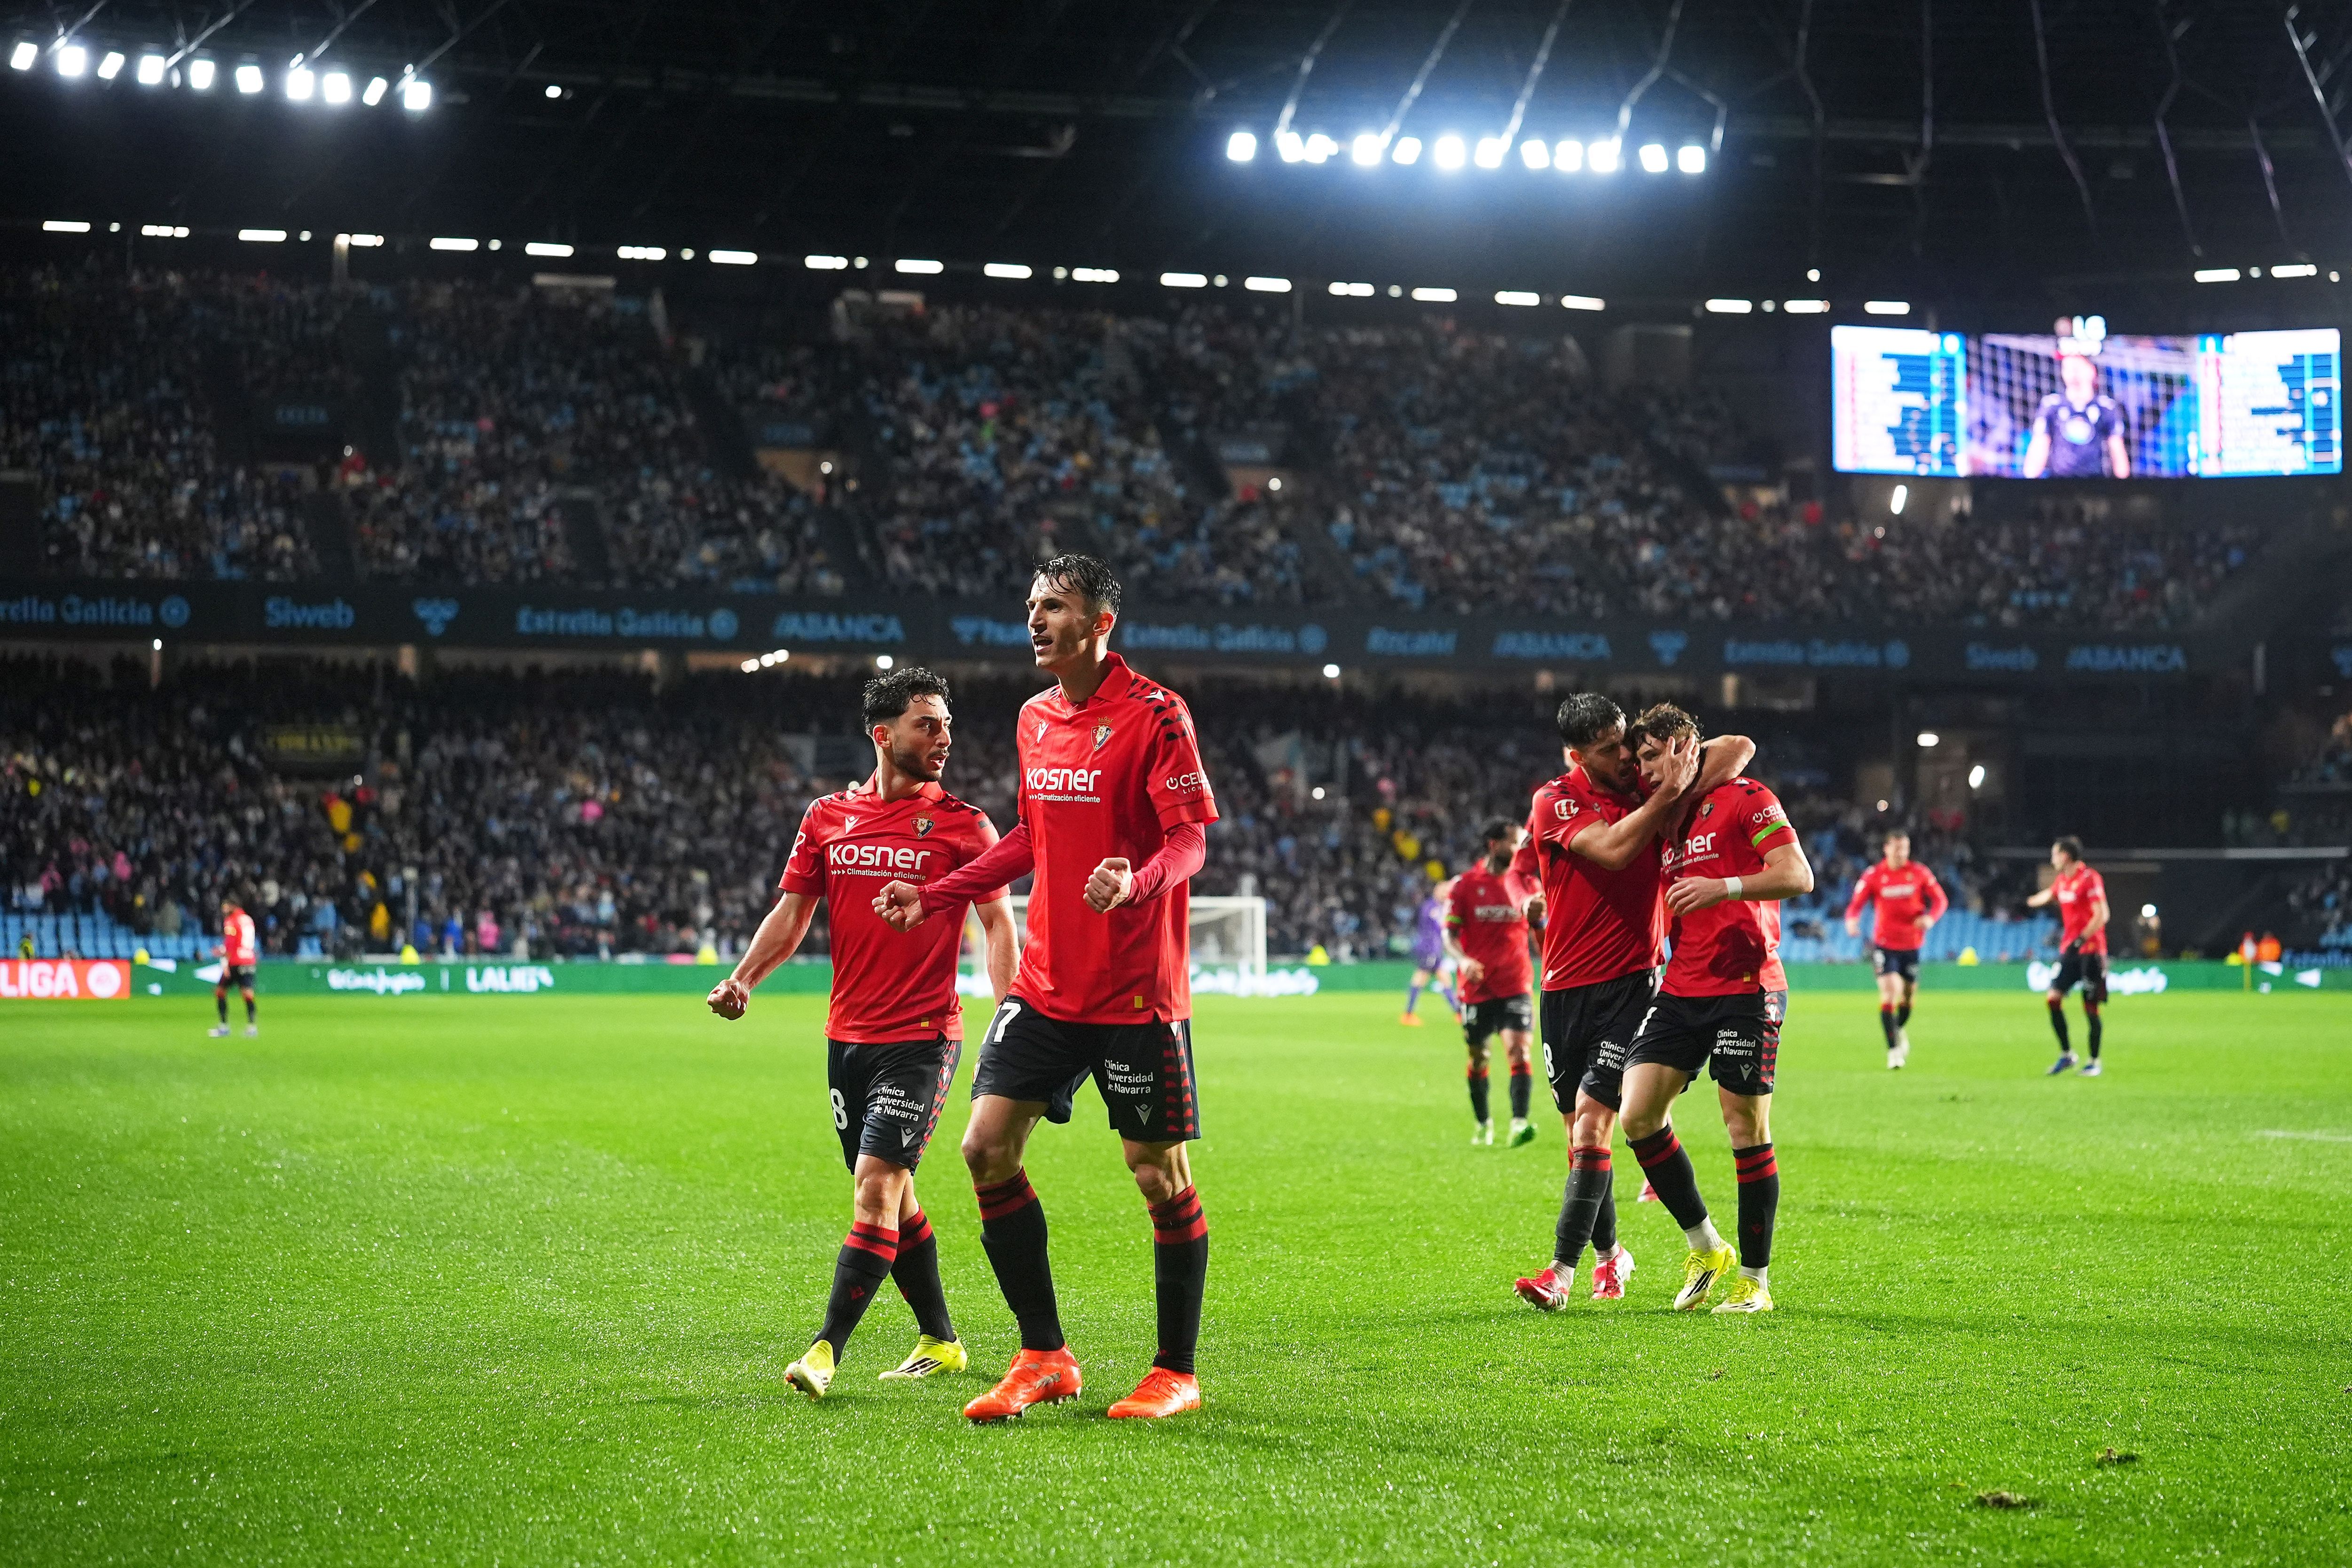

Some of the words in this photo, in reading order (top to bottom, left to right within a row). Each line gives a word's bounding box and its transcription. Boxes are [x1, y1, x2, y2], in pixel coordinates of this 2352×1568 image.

[1074, 794, 1100, 803] eficiente
[847, 868, 892, 877] Climatización
[894, 870, 926, 880] eficiente
[1716, 1038, 1756, 1047] Universidad
[1723, 1046, 1753, 1056] Navarra
[1114, 1082, 1151, 1094] Navarra
[876, 1095, 925, 1113] Universidad
[884, 1105, 919, 1122] Navarra
